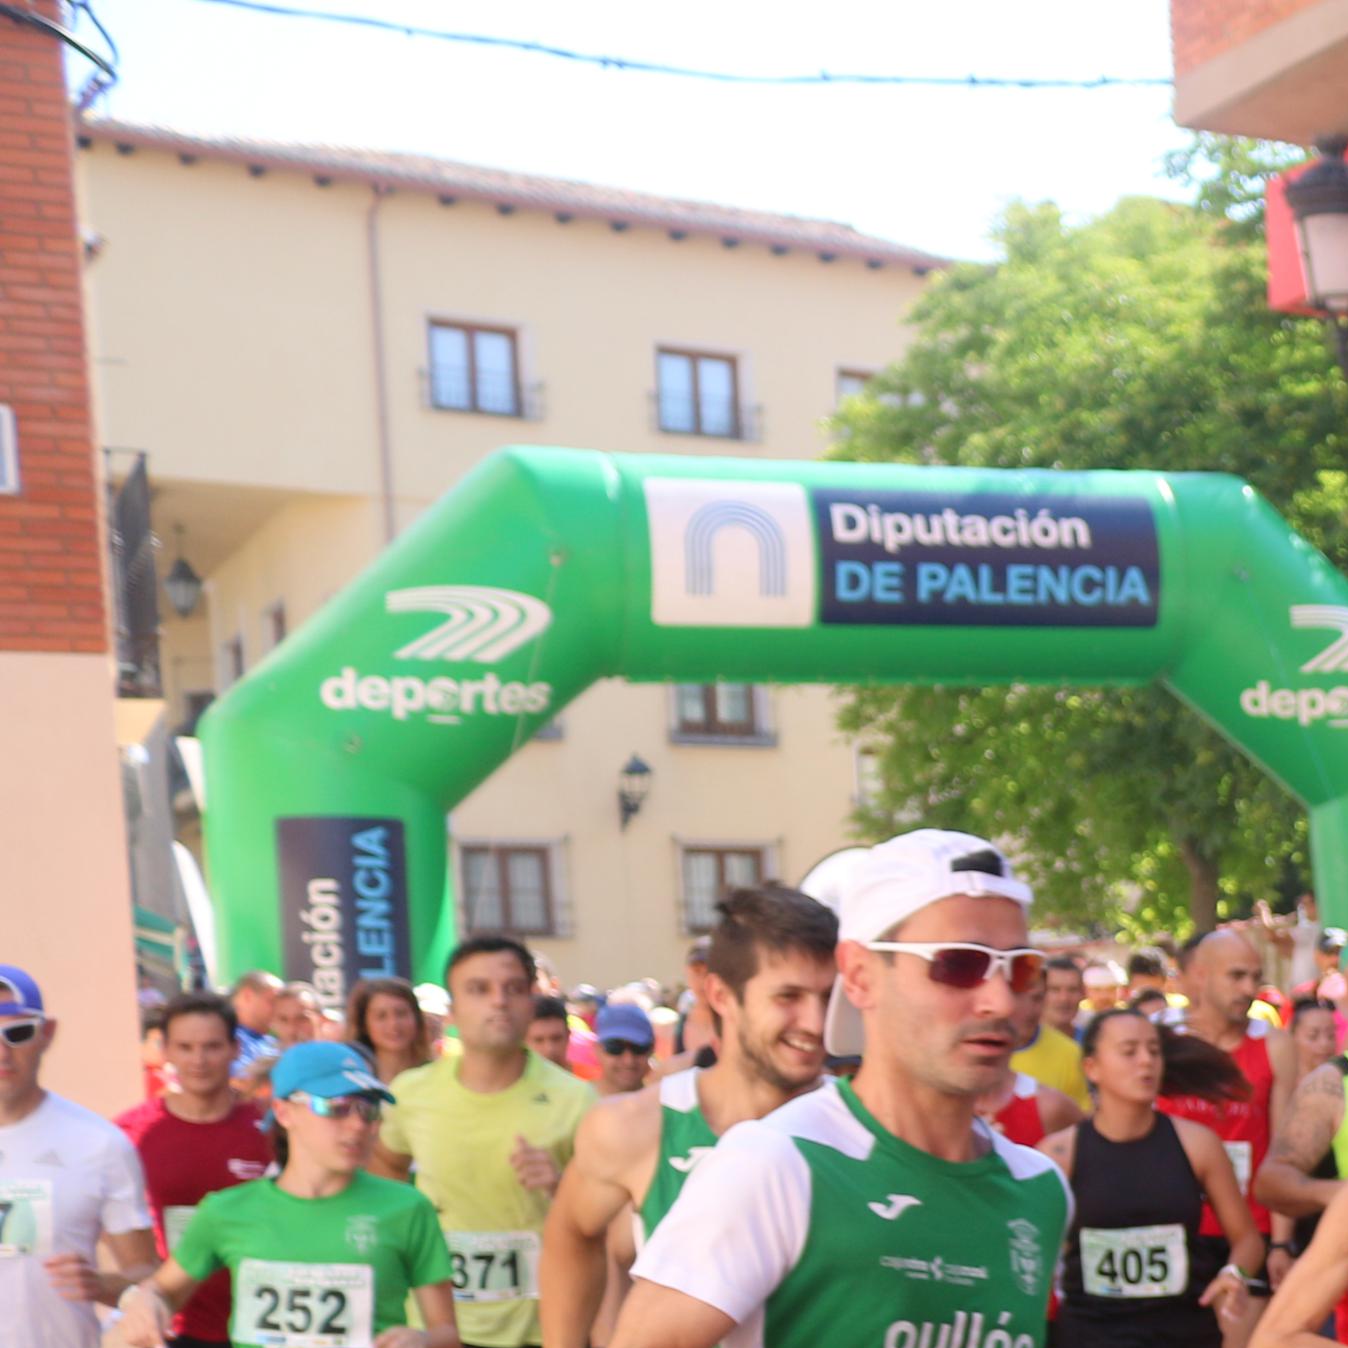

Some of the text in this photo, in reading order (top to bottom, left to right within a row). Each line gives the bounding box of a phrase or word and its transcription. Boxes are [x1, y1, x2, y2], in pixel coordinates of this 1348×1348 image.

[829, 502, 1093, 554] Diputación
[835, 560, 1153, 606] DE PALENCIA
[319, 665, 553, 724] deportes
[351, 825, 397, 981] LENCIA
[299, 876, 347, 1012] tación
[1095, 1247, 1169, 1285] 405
[255, 1286, 346, 1335] 252
